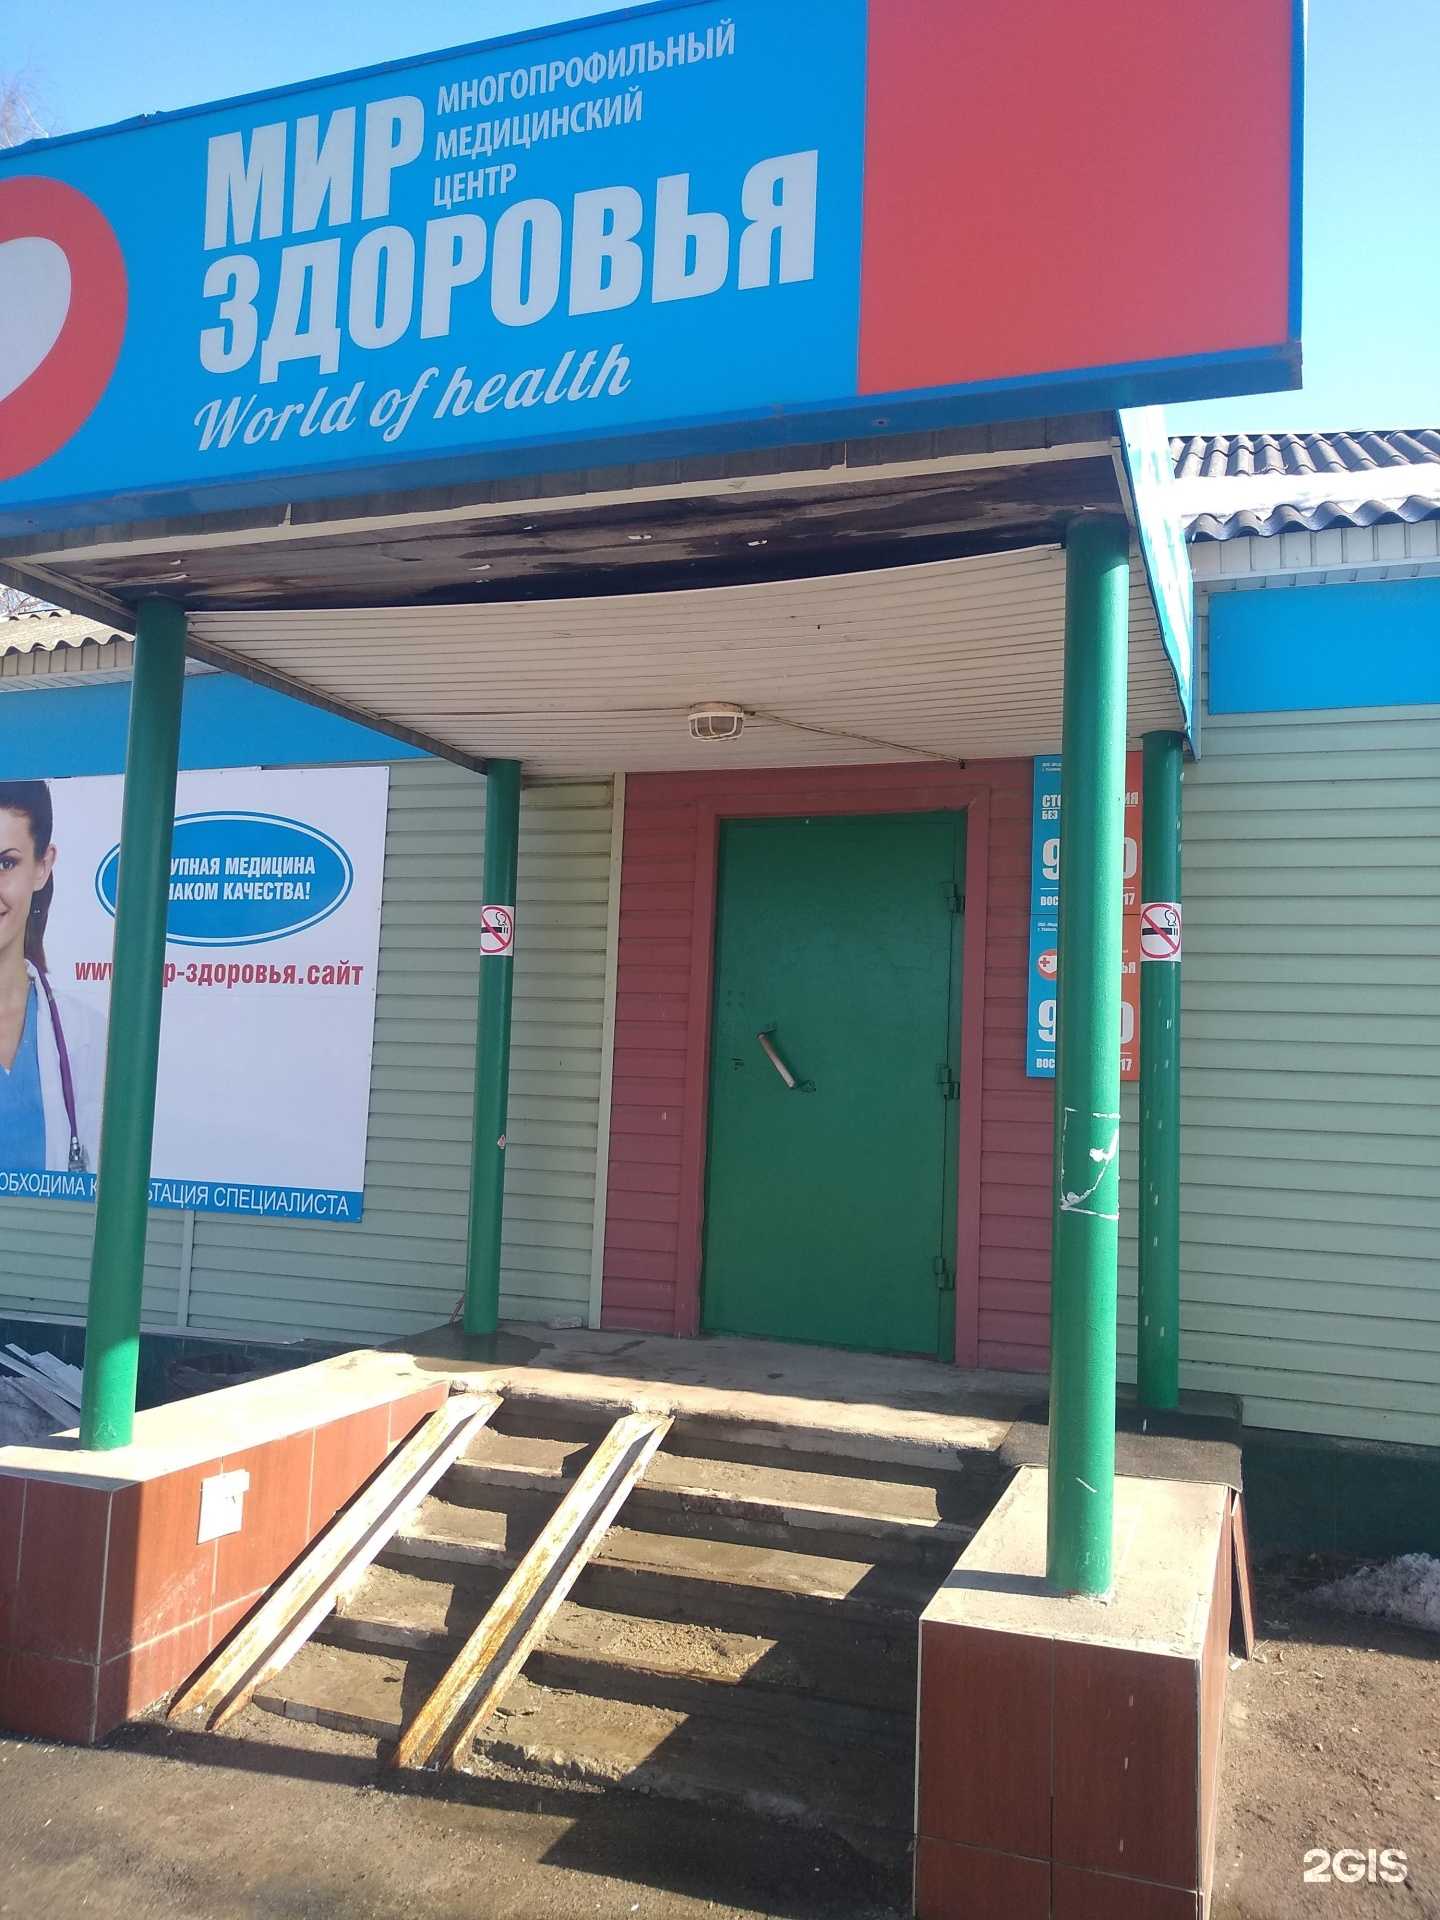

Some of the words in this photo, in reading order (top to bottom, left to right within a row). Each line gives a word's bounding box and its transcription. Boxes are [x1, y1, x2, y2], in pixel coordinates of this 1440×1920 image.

[437, 19, 736, 115] МНОГОПРОФИЛЬНЫЙ
[435, 86, 644, 161] МЕДИЦИНСКИЙ
[204, 95, 425, 250] МИР
[433, 164, 518, 209] ЦЕНТР
[200, 149, 819, 384] ЗДОРОВЬЯ
[194, 385, 366, 452] World
[368, 364, 441, 441] of
[433, 344, 632, 419] health
[168, 882, 218, 900] АКОМ
[223, 882, 311, 900] КАЧЕСТВА!
[170, 857, 220, 876] УПНАЯ
[224, 856, 316, 878] МЕДИЦИНА
[0, 1172, 86, 1196] ОБХОДИМА
[214, 1187, 349, 1215] СПЕЦИАЛИСТА
